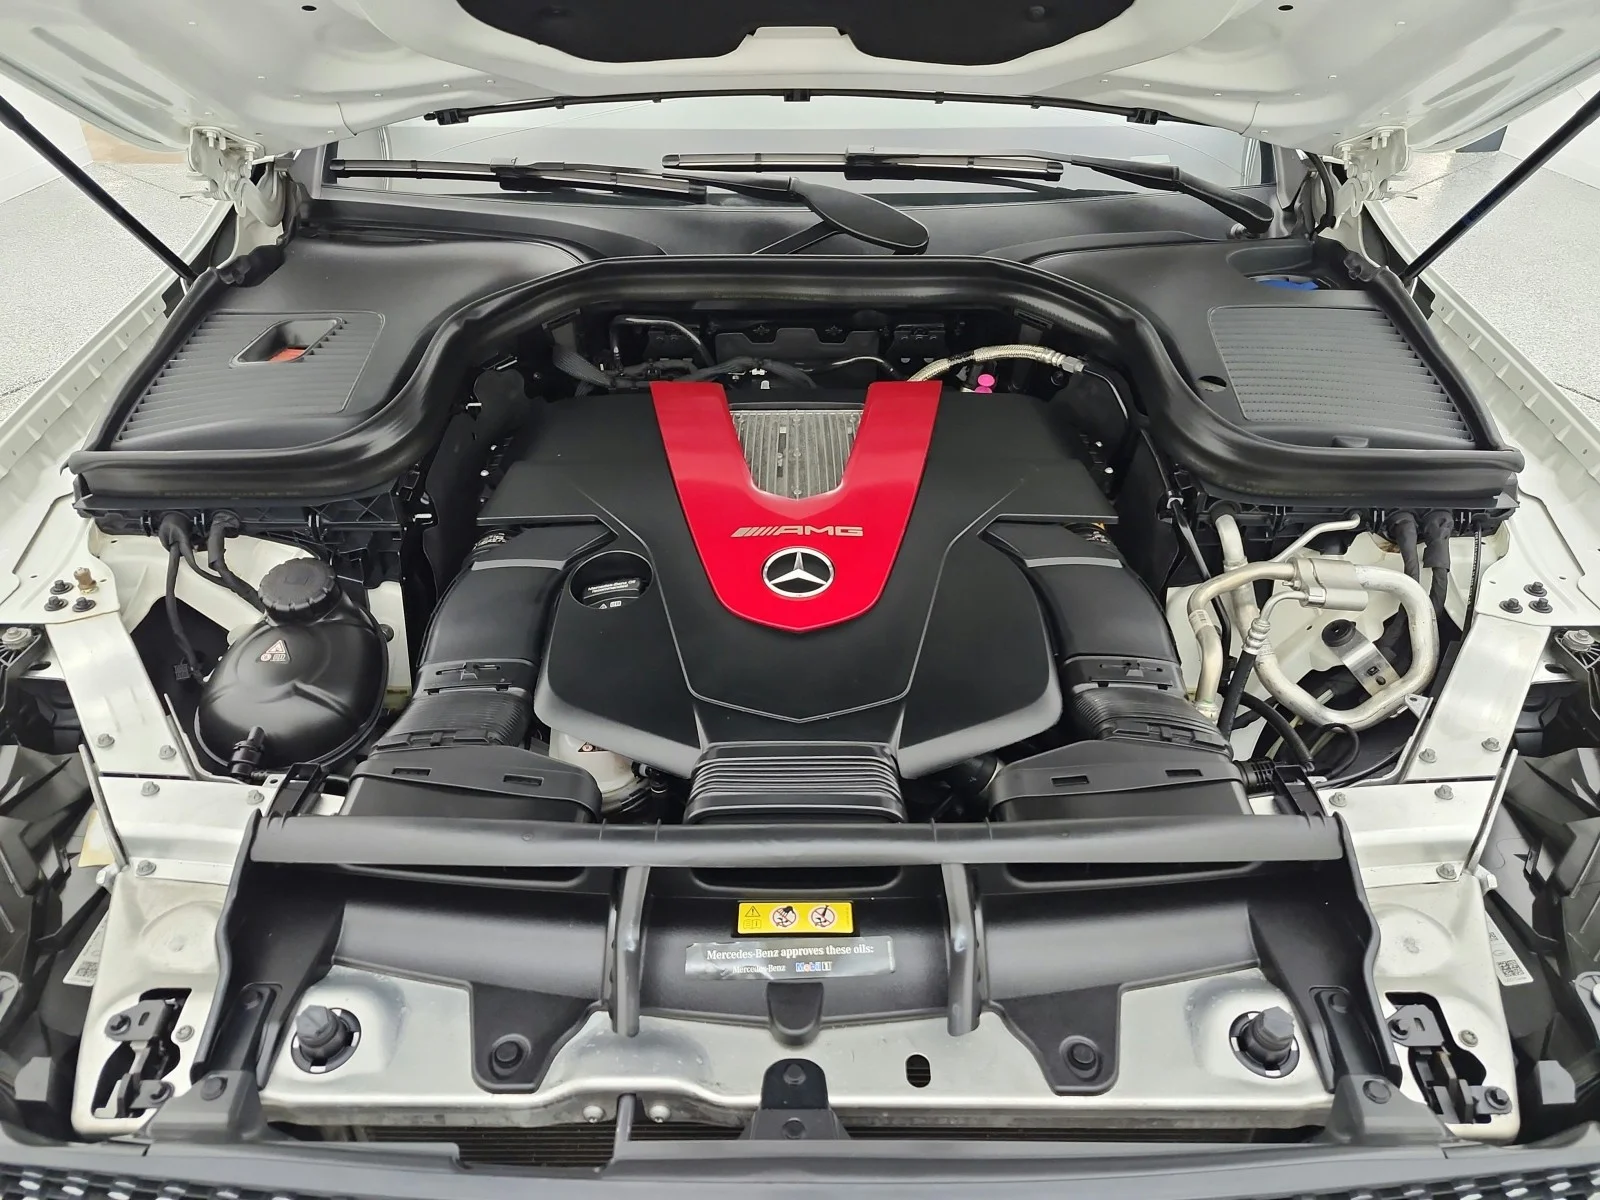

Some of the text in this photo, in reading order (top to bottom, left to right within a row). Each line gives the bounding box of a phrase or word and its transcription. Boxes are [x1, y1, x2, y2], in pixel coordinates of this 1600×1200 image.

[772, 525, 864, 537] AMG
[706, 944, 874, 960] Mercedes-Benz approves these oils:
[732, 964, 786, 974] Mercedes-Benz
[795, 961, 821, 973] Mobil
